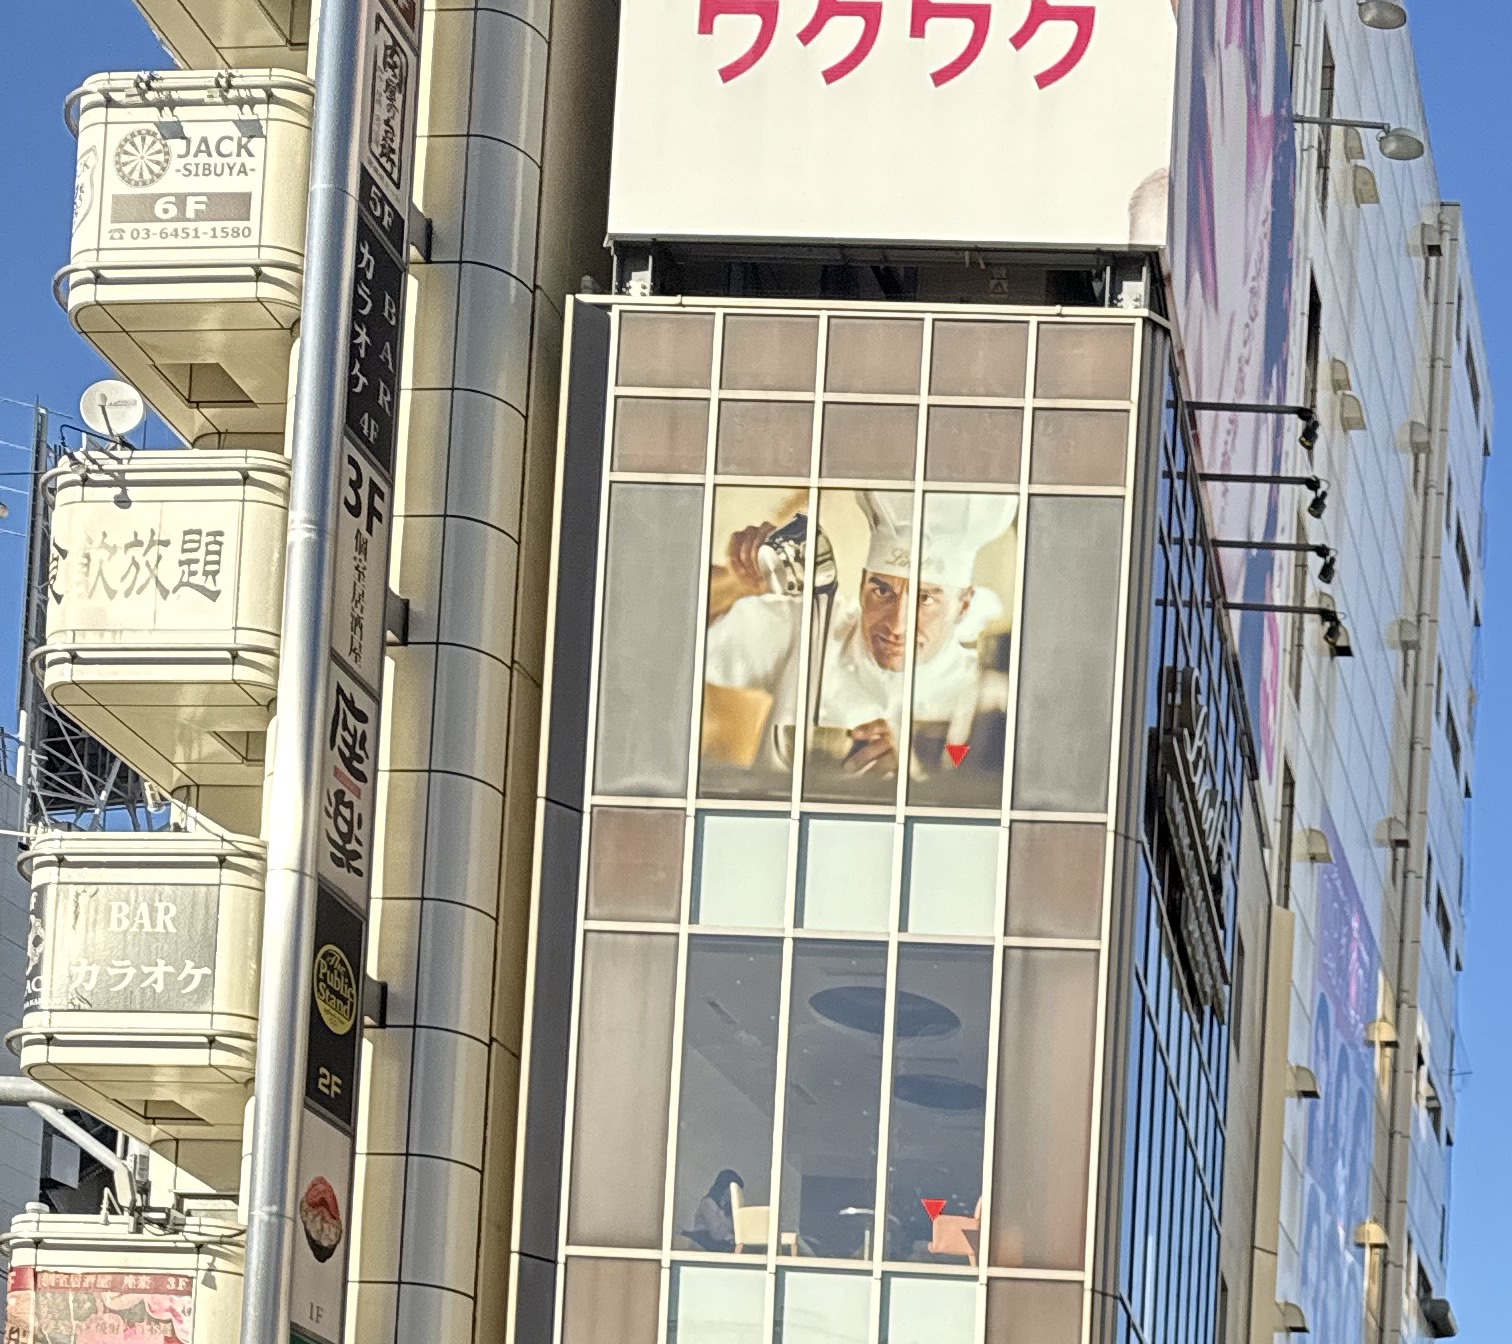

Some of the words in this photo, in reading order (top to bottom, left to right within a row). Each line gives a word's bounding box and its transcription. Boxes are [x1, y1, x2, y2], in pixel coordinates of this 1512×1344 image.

[696, 0, 1097, 90] ワクワク
[177, 134, 256, 159] JACK
[174, 161, 257, 178] -SIBUYA-
[154, 195, 210, 219] 6F
[369, 185, 395, 231] 5F
[129, 226, 252, 241] 03-6451-1580
[351, 240, 376, 393] カラオケ
[377, 290, 397, 417] BAR
[358, 411, 379, 445] 4F
[343, 453, 386, 538] 3F
[108, 900, 178, 934] BAR
[69, 957, 213, 995] カラオケ
[318, 957, 355, 1000] Public
[318, 980, 352, 1021] Stand
[318, 1066, 343, 1099] 2F
[166, 1276, 190, 1291] 3F
[308, 1302, 324, 1324] 1F
